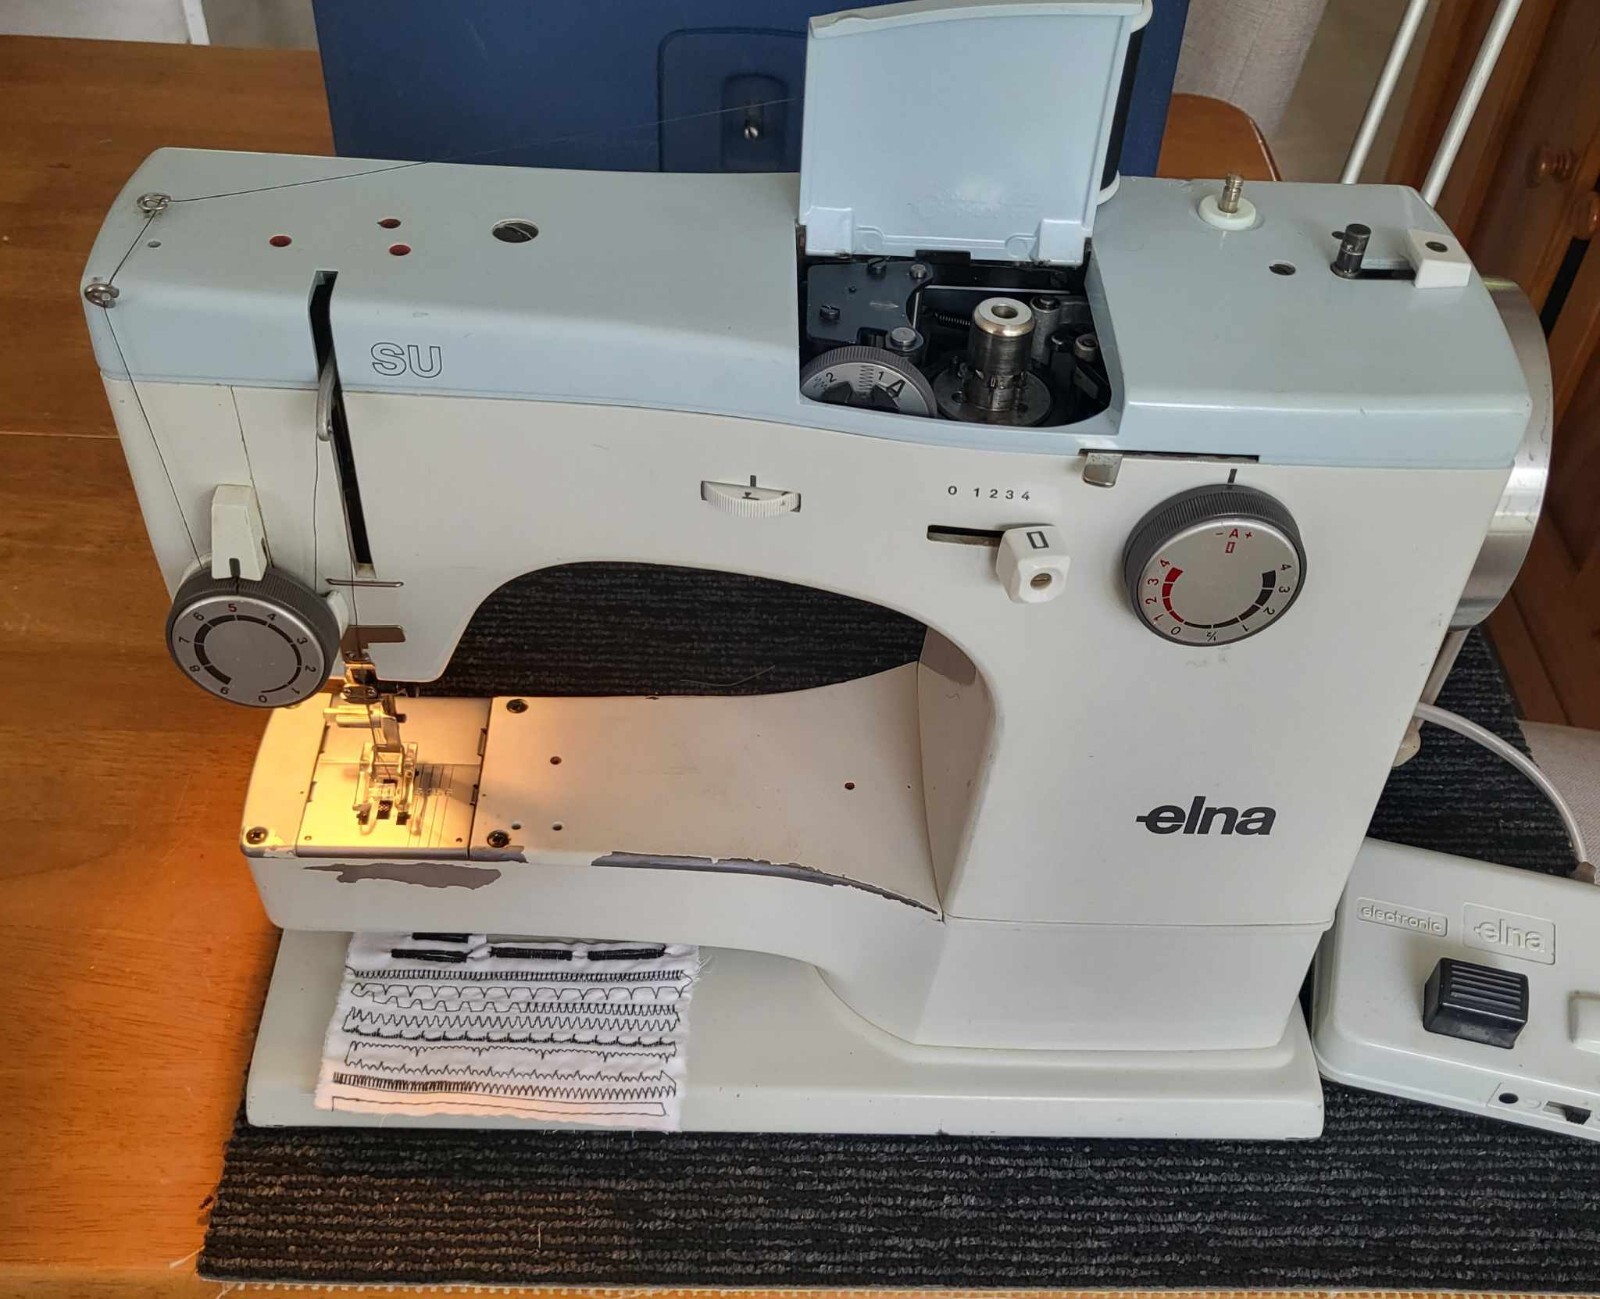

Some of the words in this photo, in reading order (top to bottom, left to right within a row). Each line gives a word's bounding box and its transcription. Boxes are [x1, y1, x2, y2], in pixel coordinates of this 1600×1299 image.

[370, 342, 442, 378] SU
[825, 372, 837, 383] 2
[877, 371, 885, 381] 1
[947, 485, 958, 495] 0
[973, 487, 980, 498] 1
[989, 488, 998, 499] 2
[1005, 489, 1014, 500] 3
[1021, 491, 1031, 501] 4
[1159, 558, 1171, 568] 4
[1280, 563, 1292, 571] 4
[1147, 578, 1160, 586] 3
[1278, 585, 1291, 594] 3
[1145, 596, 1157, 605] 2
[228, 603, 238, 613] 5
[1263, 606, 1275, 616] 2
[266, 613, 277, 621] 4
[1153, 613, 1164, 622] 1
[1170, 626, 1182, 635] 0
[1241, 624, 1250, 633] 1
[296, 636, 308, 645] 3
[189, 664, 201, 673] 8
[290, 687, 300, 695] 1
[258, 694, 268, 704] 0
[1136, 795, 1277, 836] elna
[1360, 904, 1443, 933] electronic
[1474, 918, 1545, 953] elna
